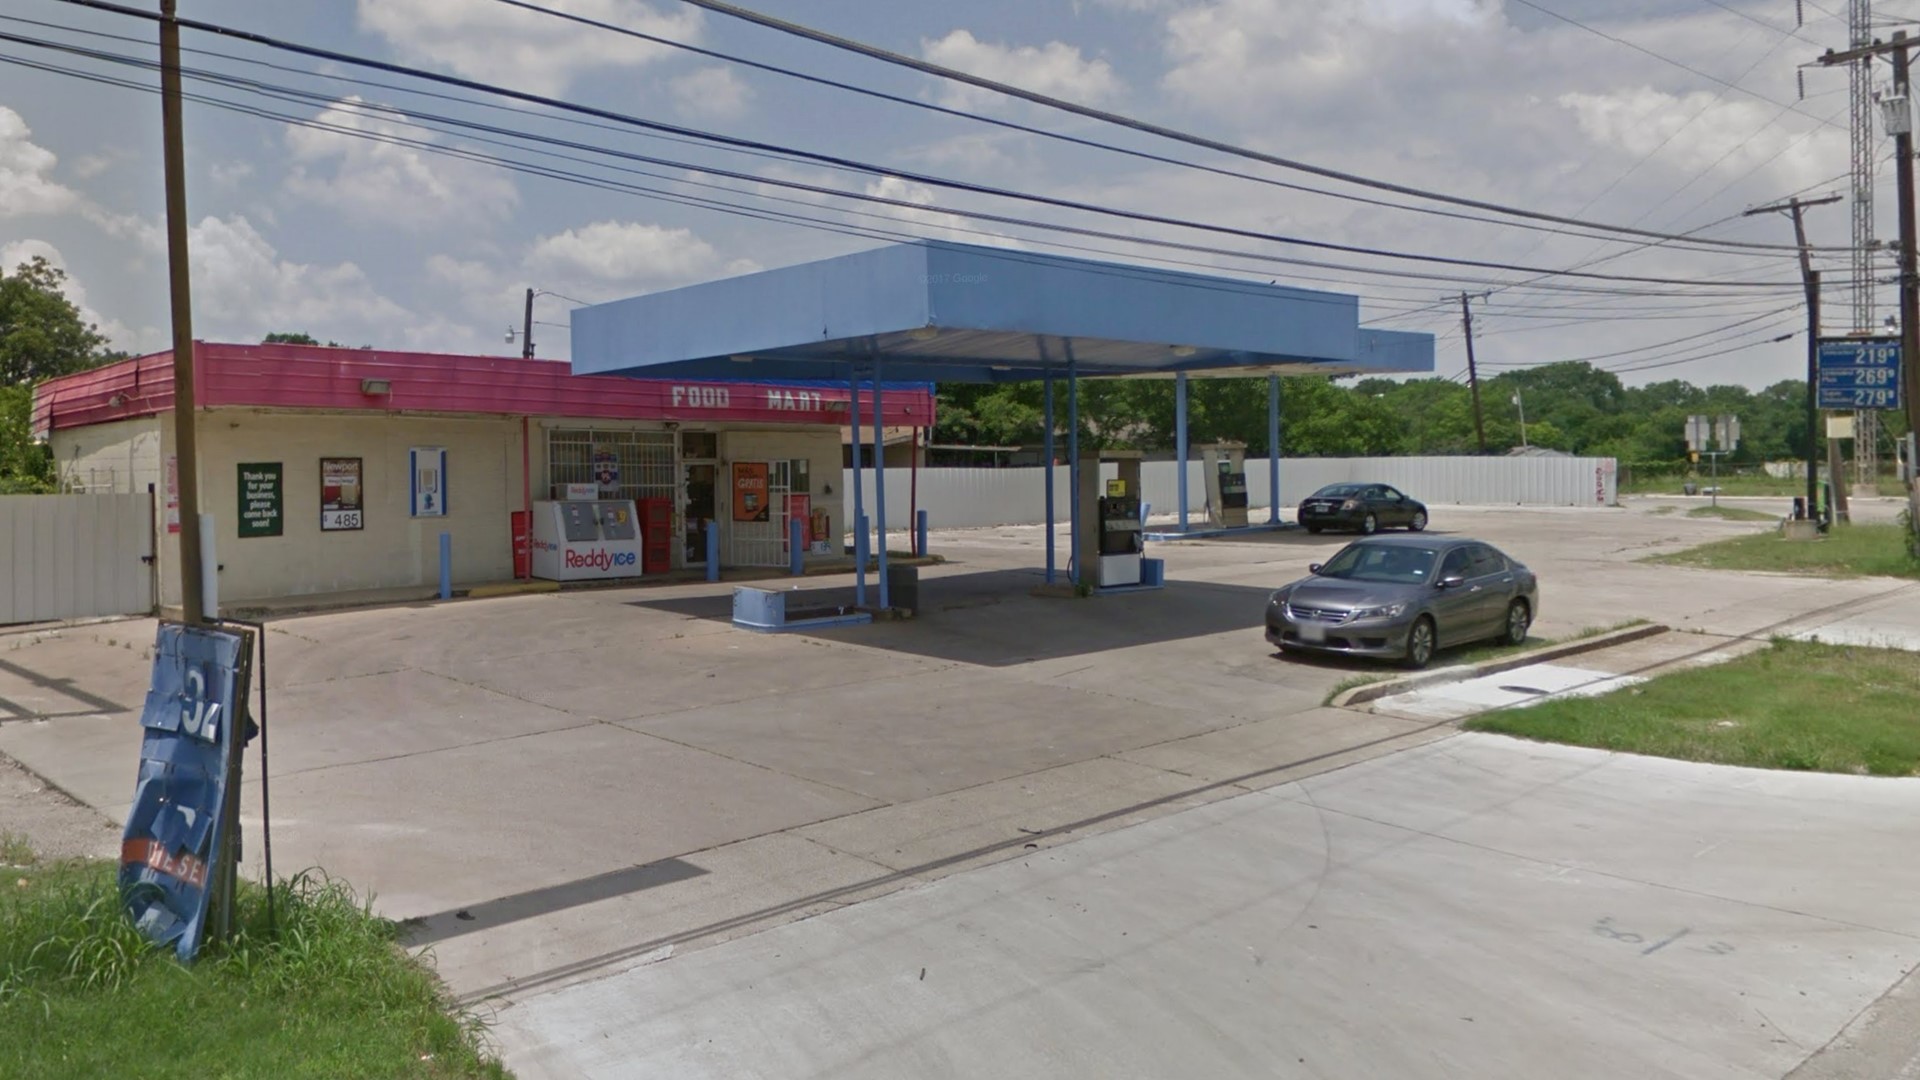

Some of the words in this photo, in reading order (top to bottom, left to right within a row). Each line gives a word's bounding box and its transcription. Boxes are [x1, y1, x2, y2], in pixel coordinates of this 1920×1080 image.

[671, 385, 730, 408] FOOD
[767, 389, 822, 412] MART
[243, 472, 263, 480] Thank
[264, 473, 277, 482] you
[247, 481, 258, 490] for
[259, 482, 274, 492] your
[250, 500, 271, 510] please
[262, 509, 277, 518] back
[334, 513, 359, 527] 485
